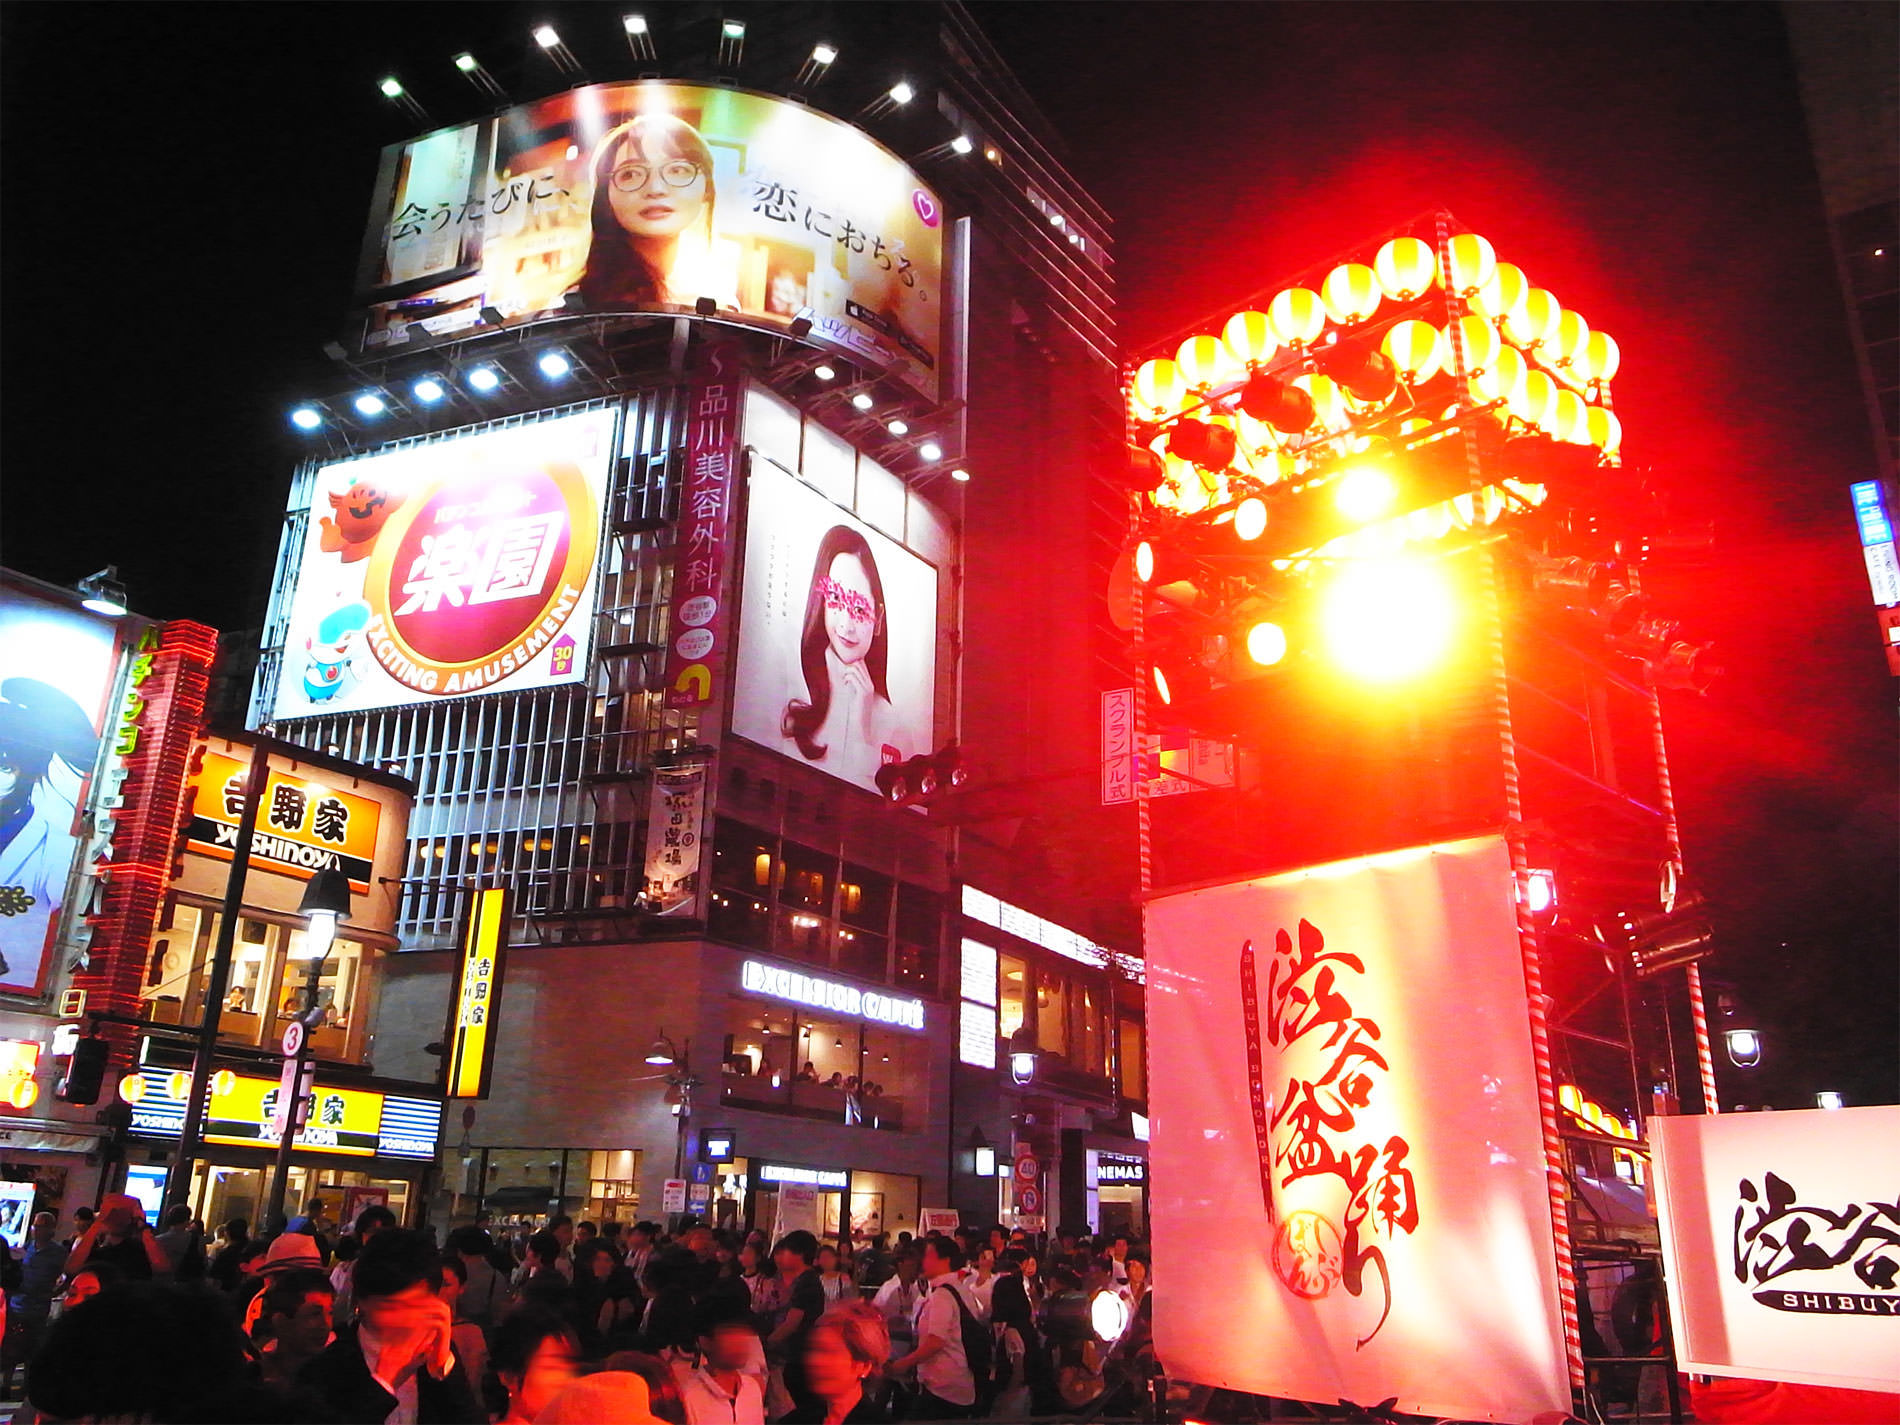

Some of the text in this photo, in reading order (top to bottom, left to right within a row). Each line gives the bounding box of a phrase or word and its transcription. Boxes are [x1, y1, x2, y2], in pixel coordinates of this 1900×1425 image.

[392, 175, 571, 241] 会うたびに、
[753, 181, 928, 302] 恋におちる。
[685, 384, 728, 592] 品川美容外科
[394, 510, 565, 616] 楽園
[442, 583, 580, 693] AMUSEMENT
[1109, 695, 1127, 799] スクランブル式
[287, 1027, 299, 1050] 3
